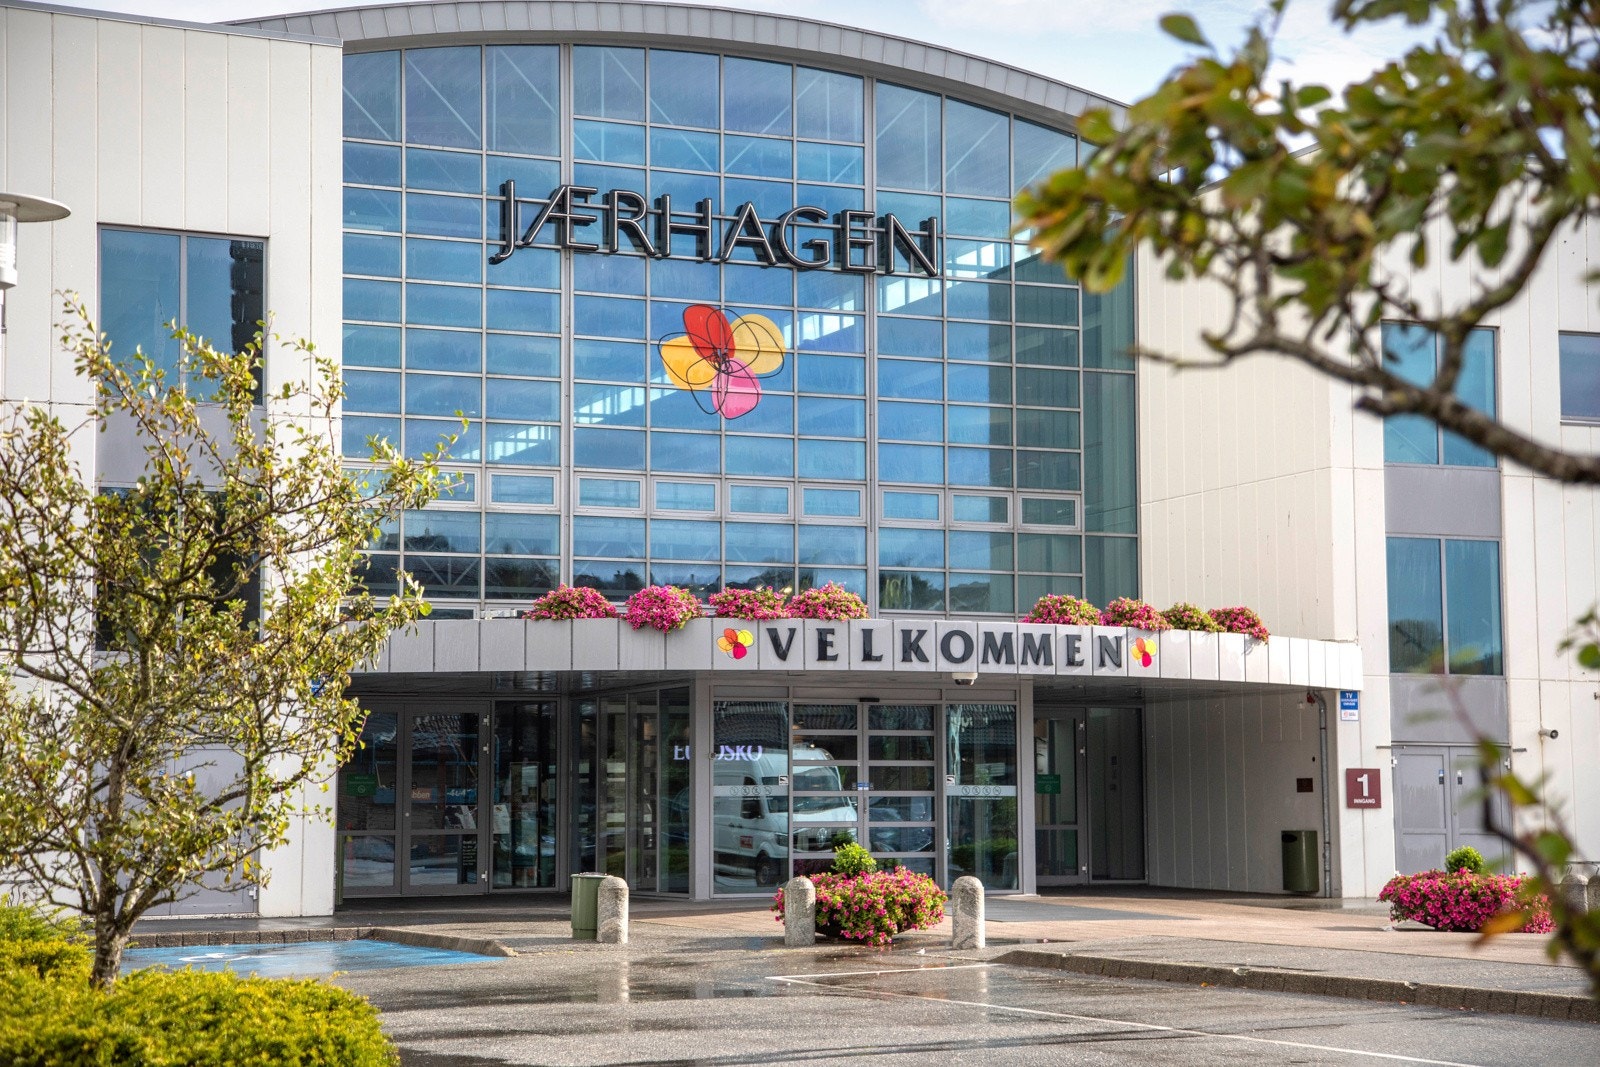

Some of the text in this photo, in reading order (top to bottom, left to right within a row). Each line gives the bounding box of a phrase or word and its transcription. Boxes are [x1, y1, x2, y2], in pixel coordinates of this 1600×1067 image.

[489, 179, 938, 277] JÆRHAGEN
[766, 627, 1123, 668] VELKOMMEN
[1357, 774, 1368, 796] 1
